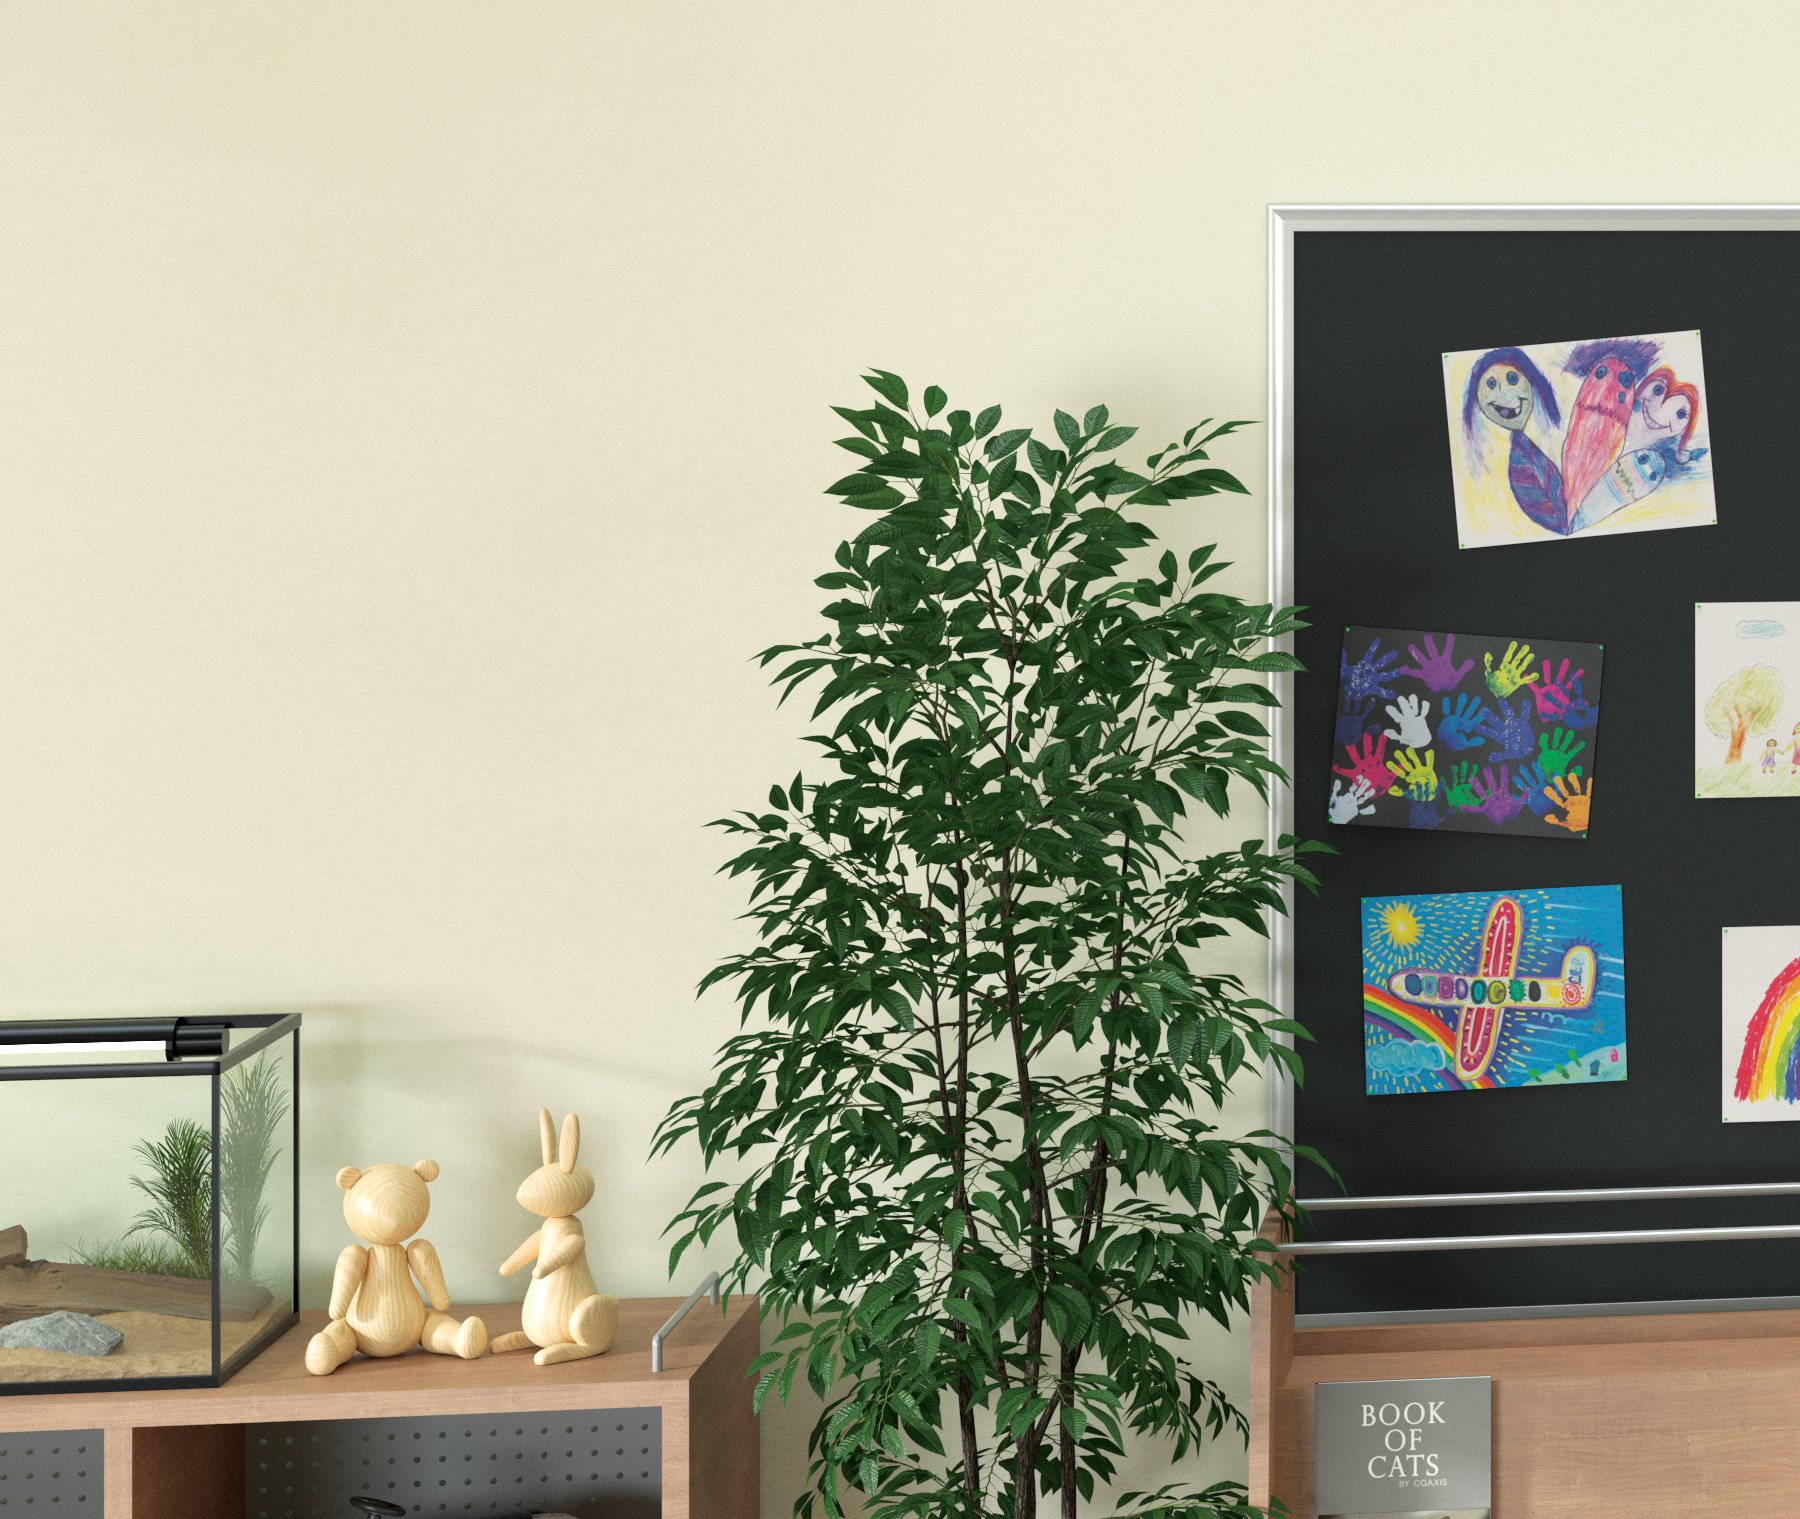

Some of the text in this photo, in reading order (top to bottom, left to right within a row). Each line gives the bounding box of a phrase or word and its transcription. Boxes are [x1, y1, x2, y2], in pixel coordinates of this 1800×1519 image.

[1361, 1401, 1446, 1427] BOOK
[1384, 1428, 1423, 1452] OF
[1367, 1453, 1440, 1479] CATS
[1414, 1478, 1448, 1488] CGAXIS
